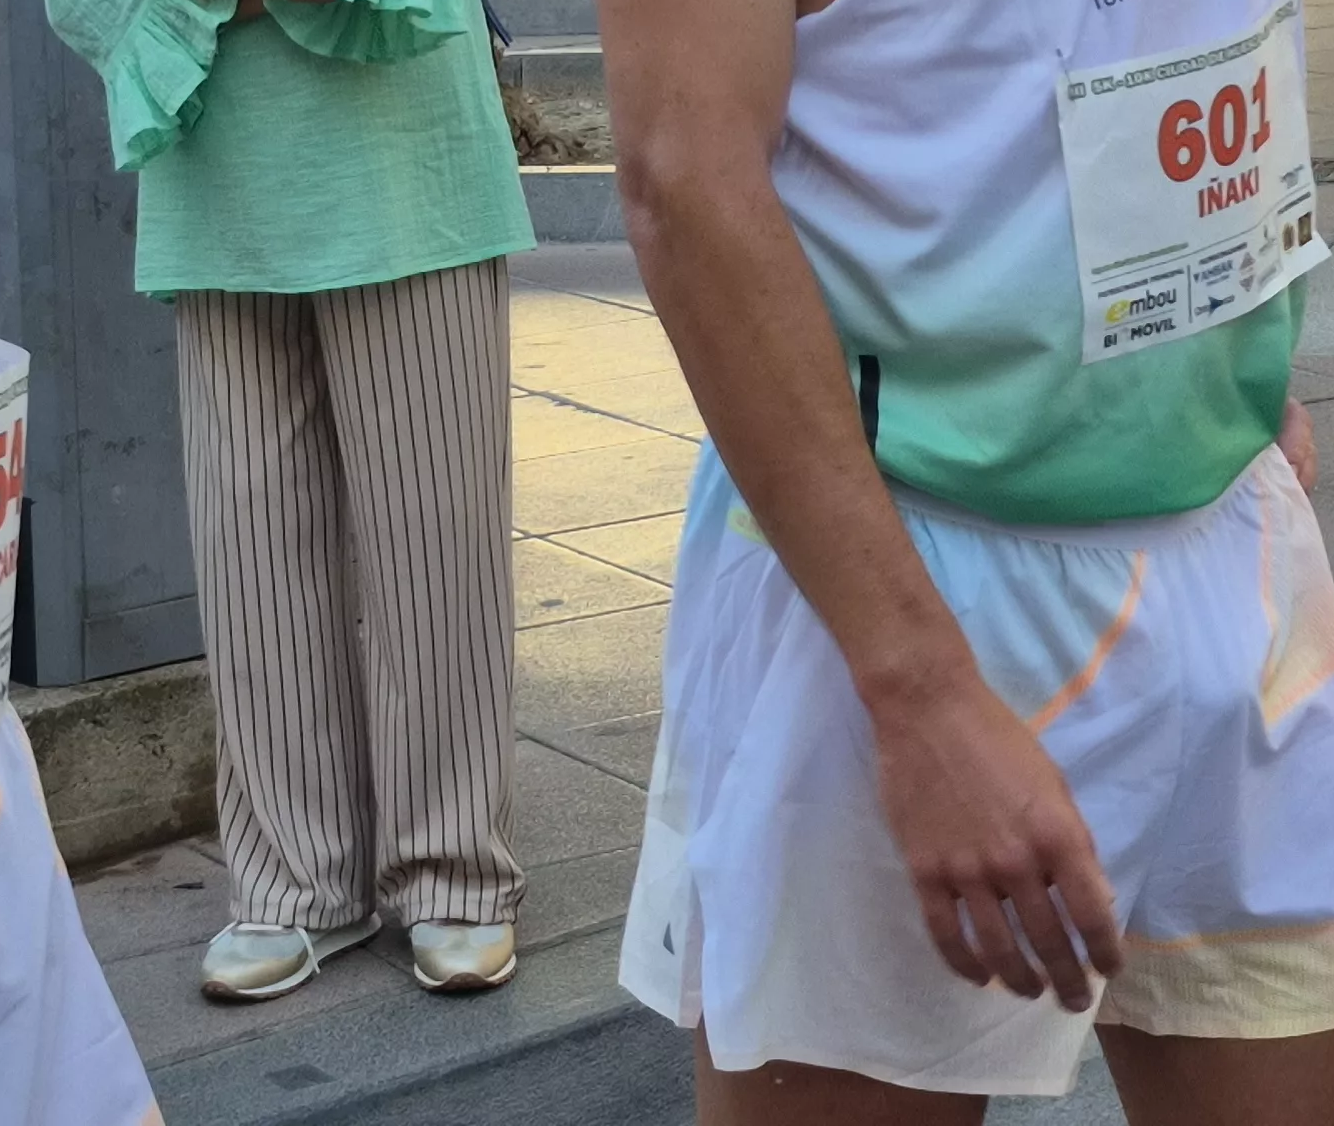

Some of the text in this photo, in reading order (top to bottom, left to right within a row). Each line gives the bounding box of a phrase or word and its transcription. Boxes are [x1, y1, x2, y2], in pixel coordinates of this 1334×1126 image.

[1157, 66, 1271, 183] 601
[1198, 166, 1259, 218] IÑAKI
[1105, 288, 1177, 324] embou
